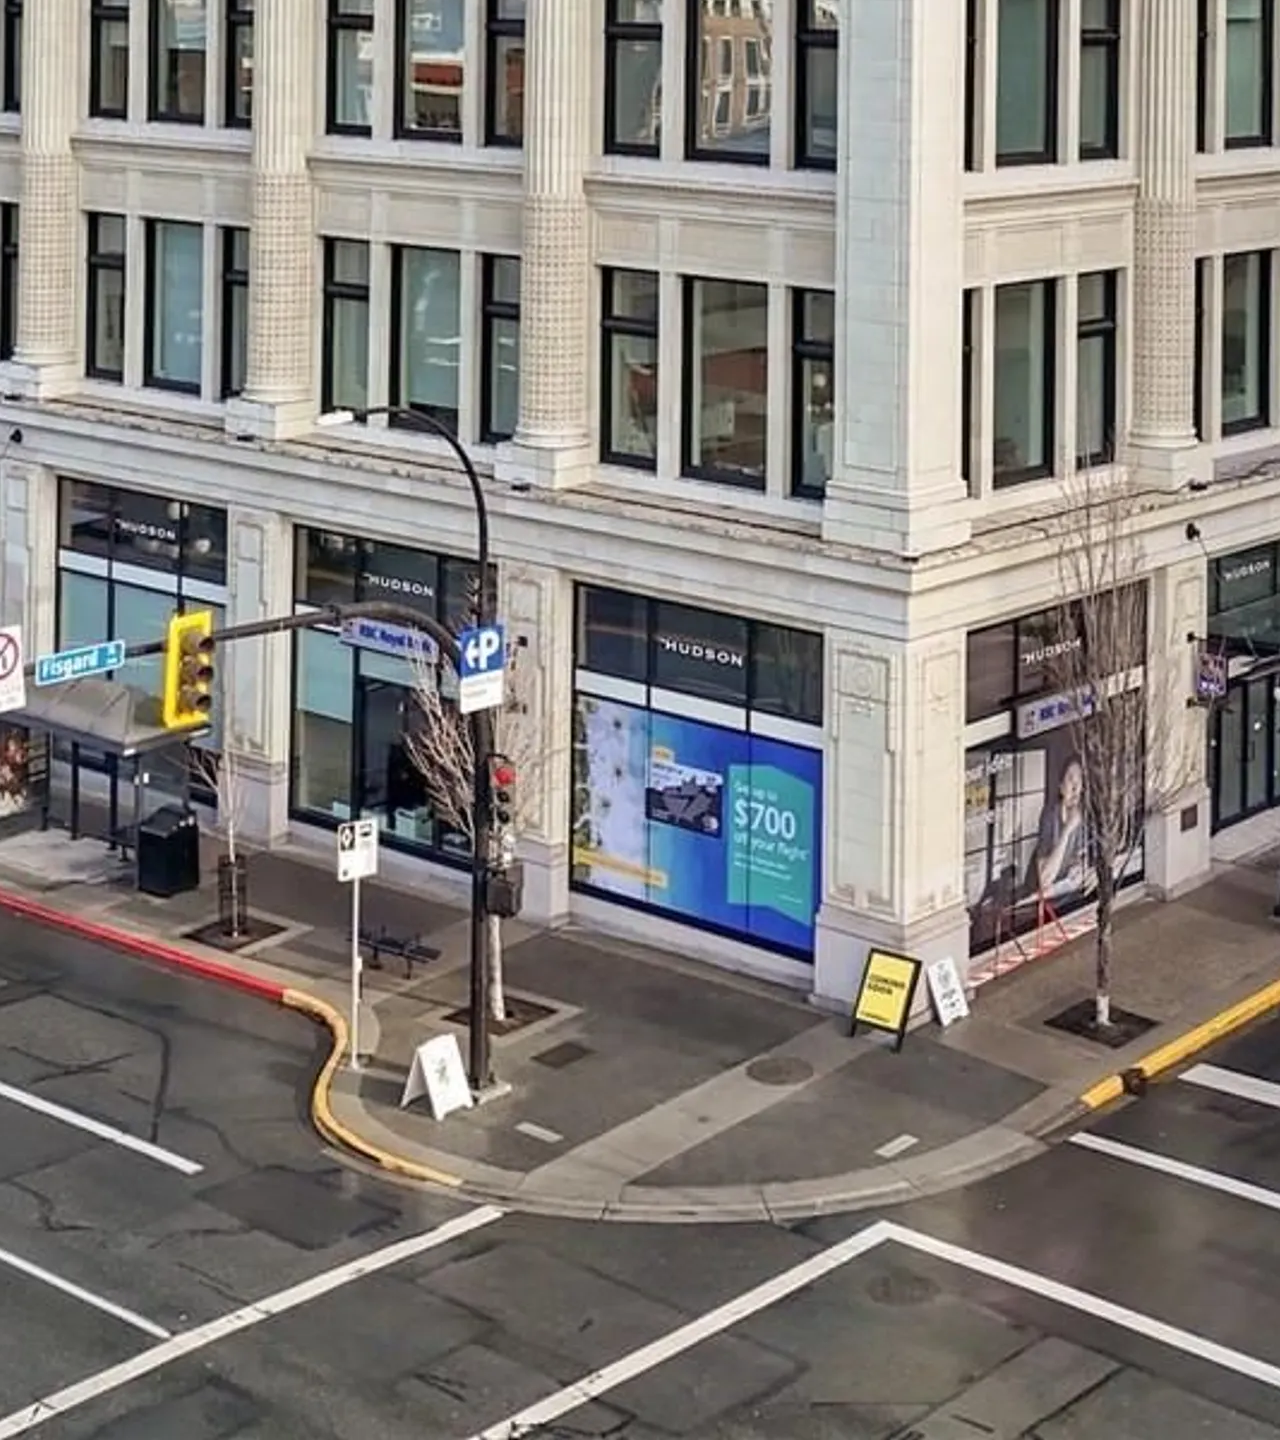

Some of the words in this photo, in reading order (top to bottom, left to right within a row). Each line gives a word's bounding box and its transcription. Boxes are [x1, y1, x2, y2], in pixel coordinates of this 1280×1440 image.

[363, 572, 434, 597] HUDSON
[41, 648, 99, 679] Fisgard
[659, 636, 744, 667] HUDSON
[735, 799, 795, 840] $700
